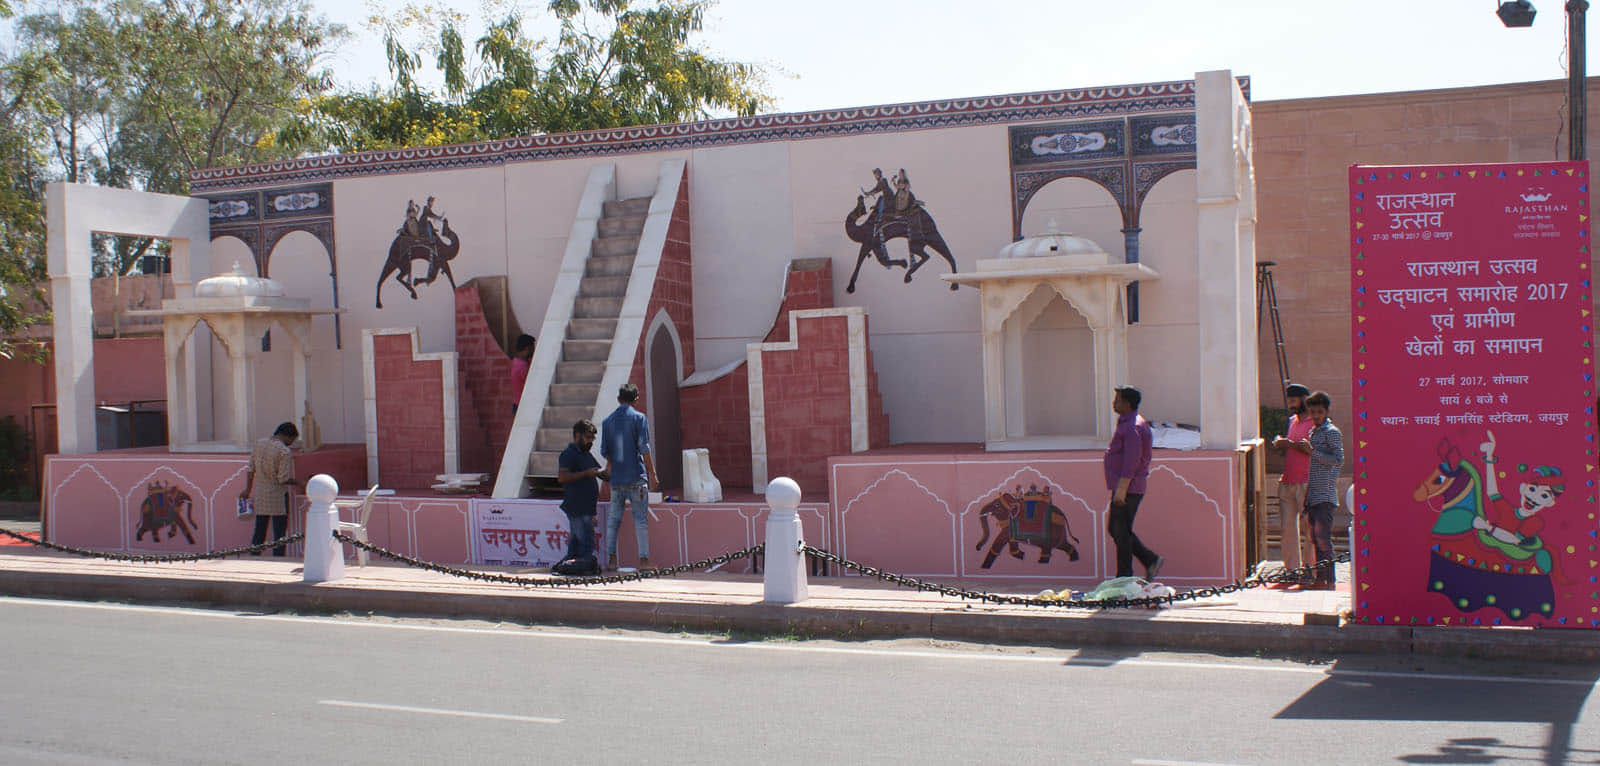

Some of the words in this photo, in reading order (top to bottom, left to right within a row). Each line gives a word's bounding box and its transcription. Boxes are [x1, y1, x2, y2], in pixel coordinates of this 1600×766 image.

[1376, 192, 1457, 210] राजस्थान
[1504, 204, 1568, 214] RAJASTHAN
[1389, 211, 1444, 229] उत्सव
[1406, 260, 1480, 277] राजस्थान
[1488, 259, 1538, 274] उत्सव
[1457, 281, 1518, 302] समारोह
[1527, 283, 1569, 301] 2017
[1430, 308, 1455, 332] एवं
[1463, 307, 1515, 328] ग्रामीण
[1404, 335, 1444, 356] खेलों
[1452, 339, 1475, 355] का
[1484, 338, 1543, 354] समापन
[1418, 377, 1431, 387] 27
[1435, 375, 1455, 386] मार्च
[1492, 373, 1529, 385] सोमवार
[1440, 394, 1460, 406] सायं
[1464, 396, 1472, 405] 6
[1476, 393, 1493, 405] बजे
[1498, 392, 1509, 404] से
[1414, 413, 1440, 425] सवाई
[1445, 411, 1484, 425] मानसिंह
[1538, 412, 1569, 426] जयपुर
[481, 528, 541, 557] जयपुर
